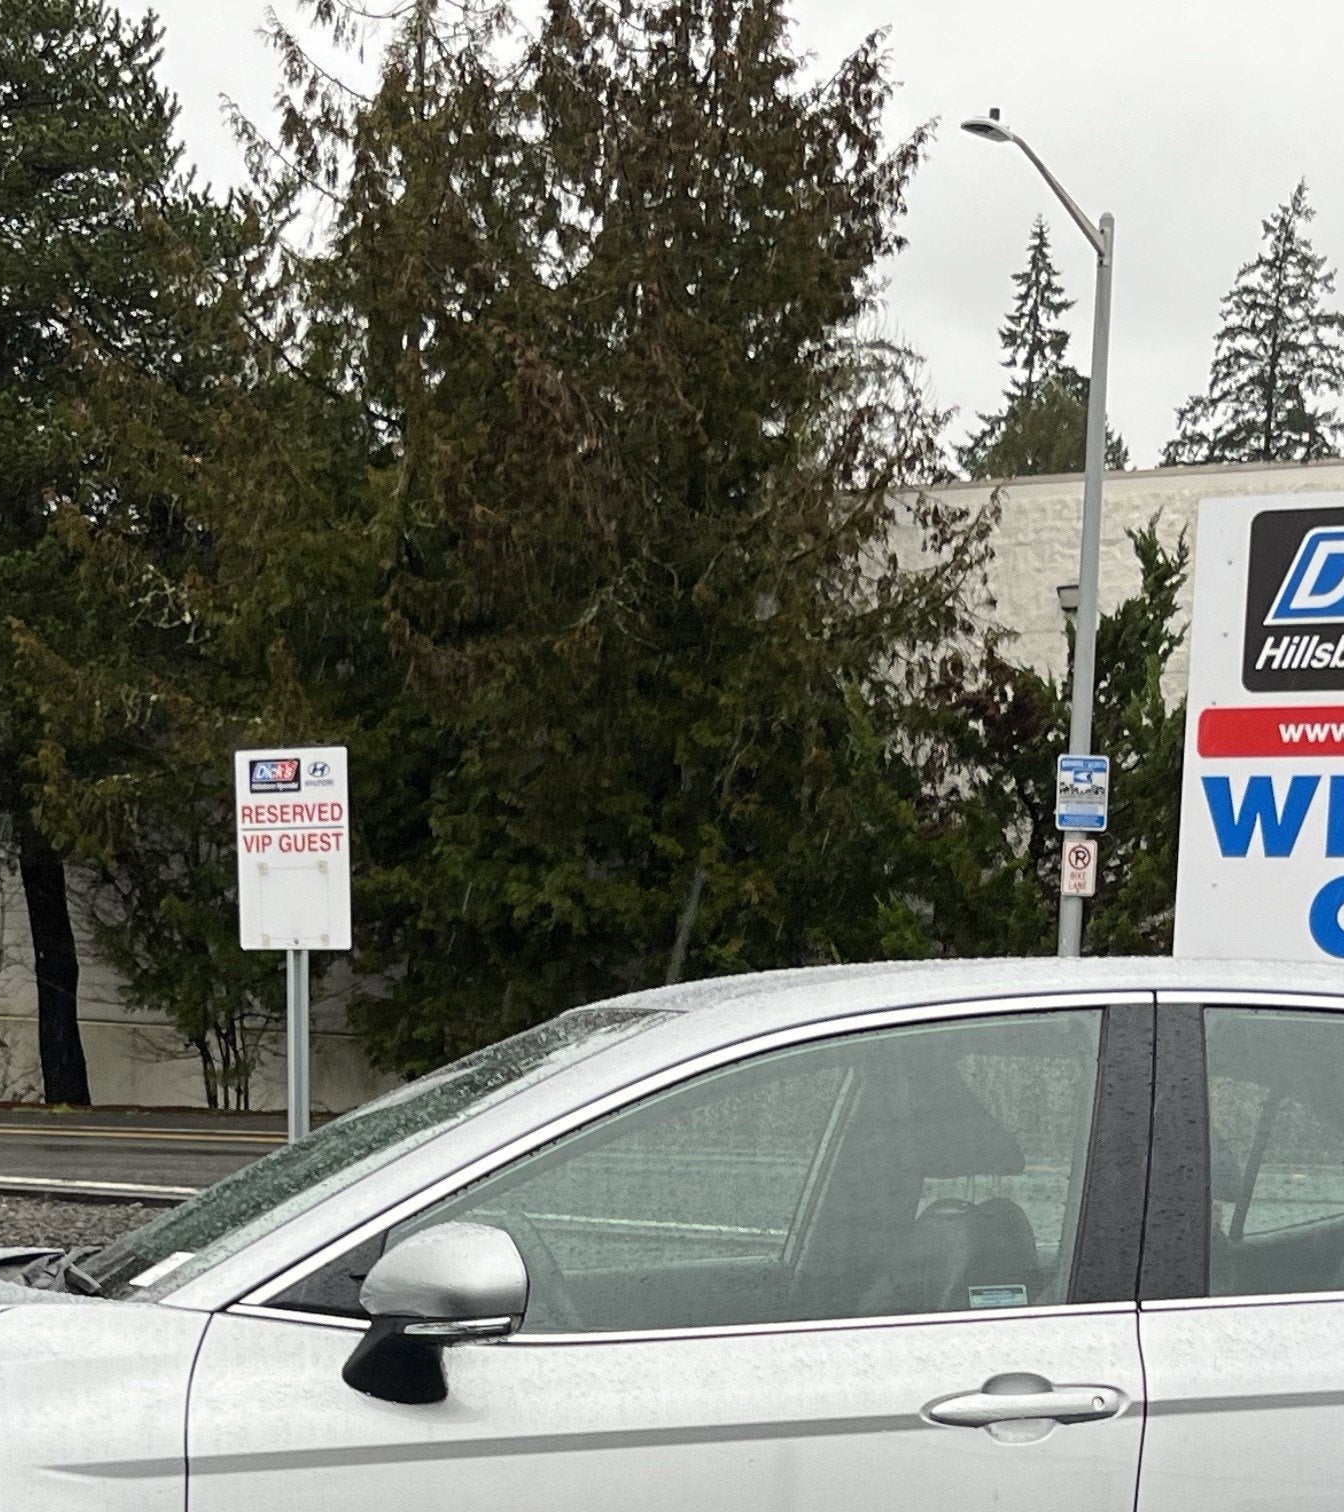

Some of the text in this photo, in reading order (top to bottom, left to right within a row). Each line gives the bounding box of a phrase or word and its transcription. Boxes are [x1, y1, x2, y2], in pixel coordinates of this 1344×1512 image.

[241, 803, 343, 824] RESERVED
[242, 833, 343, 853] VIP GUEST
